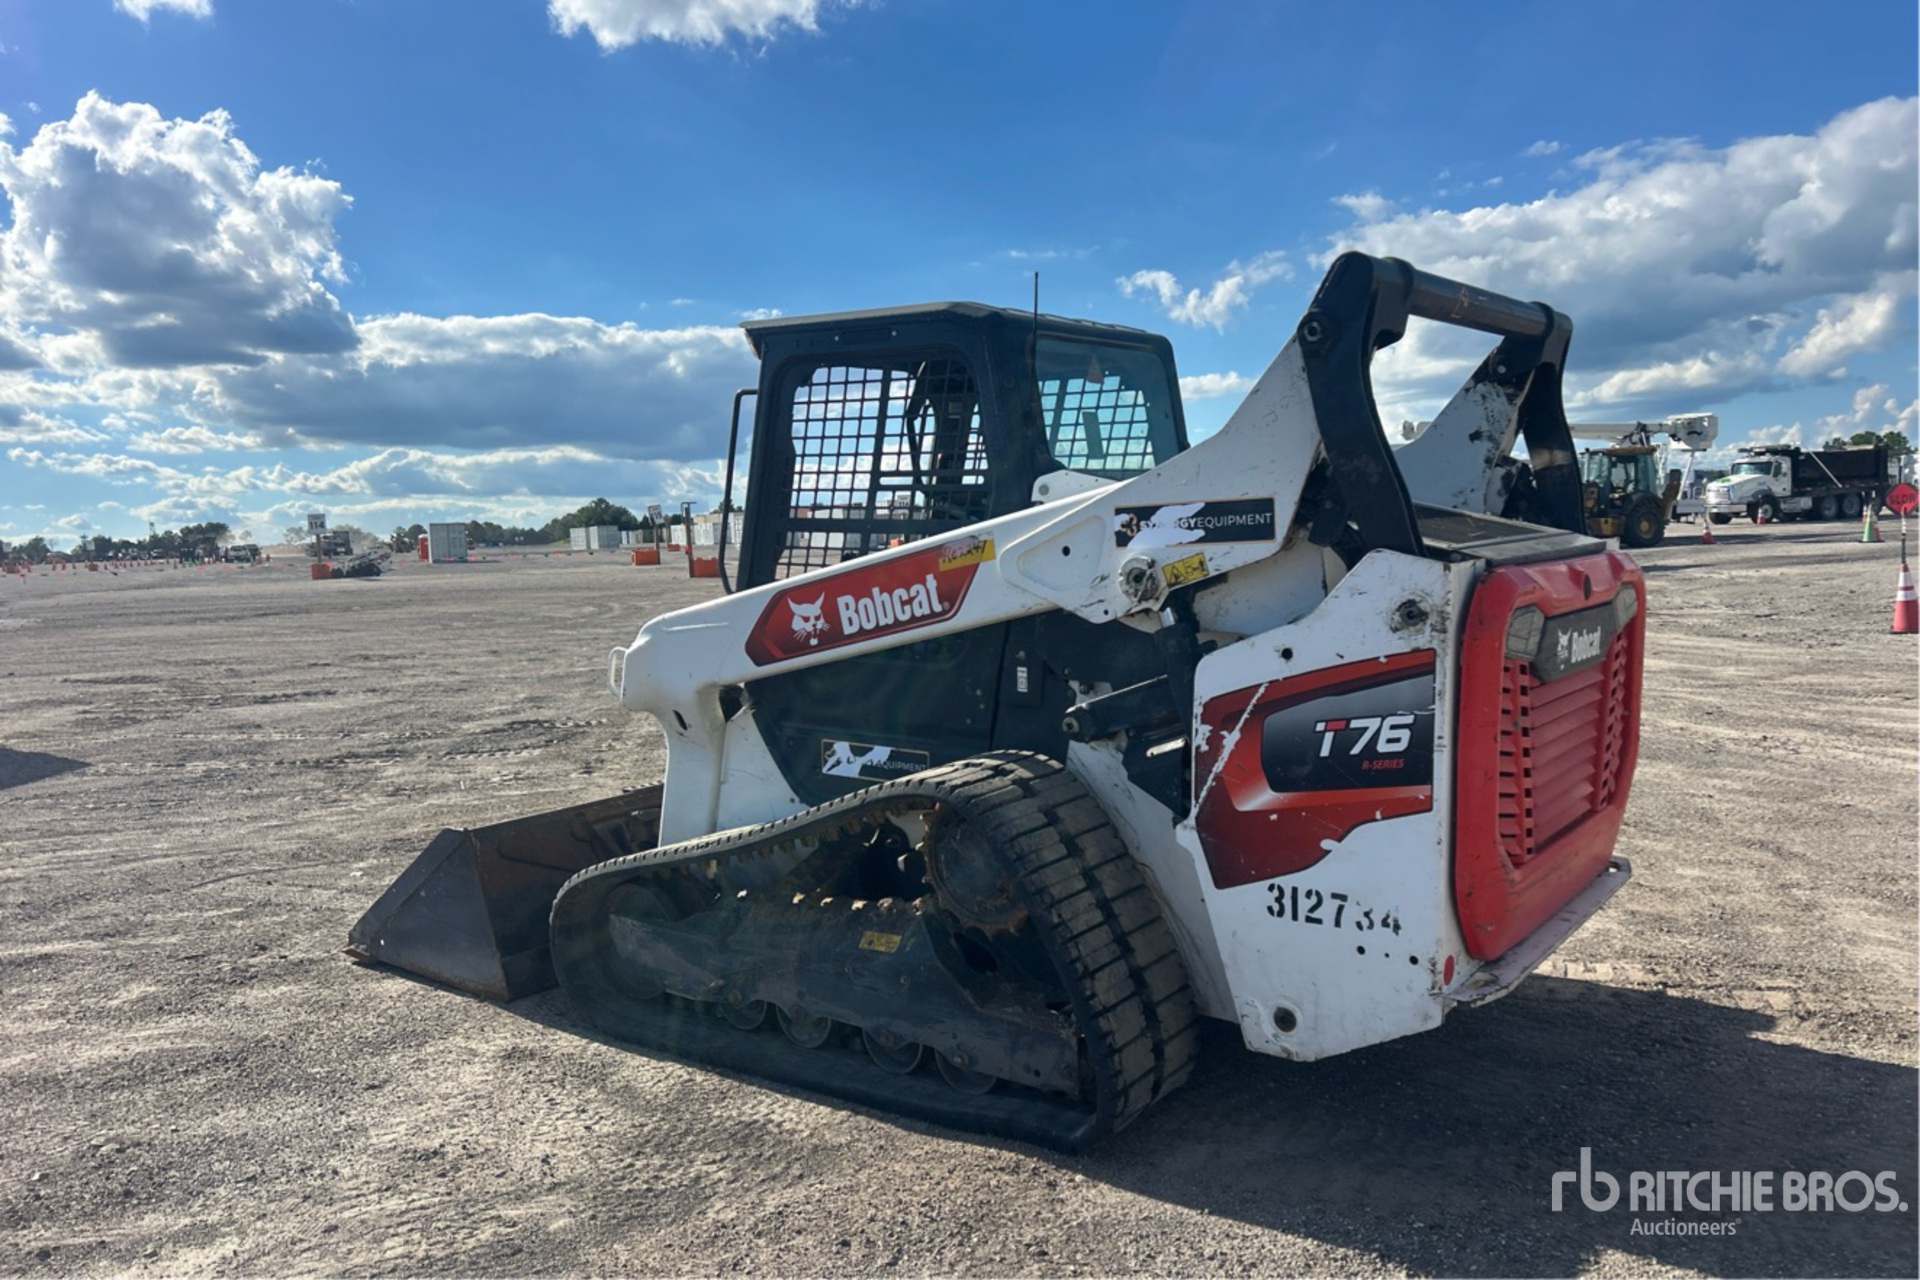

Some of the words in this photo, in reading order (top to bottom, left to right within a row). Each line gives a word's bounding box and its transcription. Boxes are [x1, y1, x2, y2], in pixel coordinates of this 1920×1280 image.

[309, 521, 325, 530] 114
[1570, 625, 1602, 664] Bobcat
[1314, 713, 1416, 758] T76
[1361, 758, 1405, 770] R-SERIES
